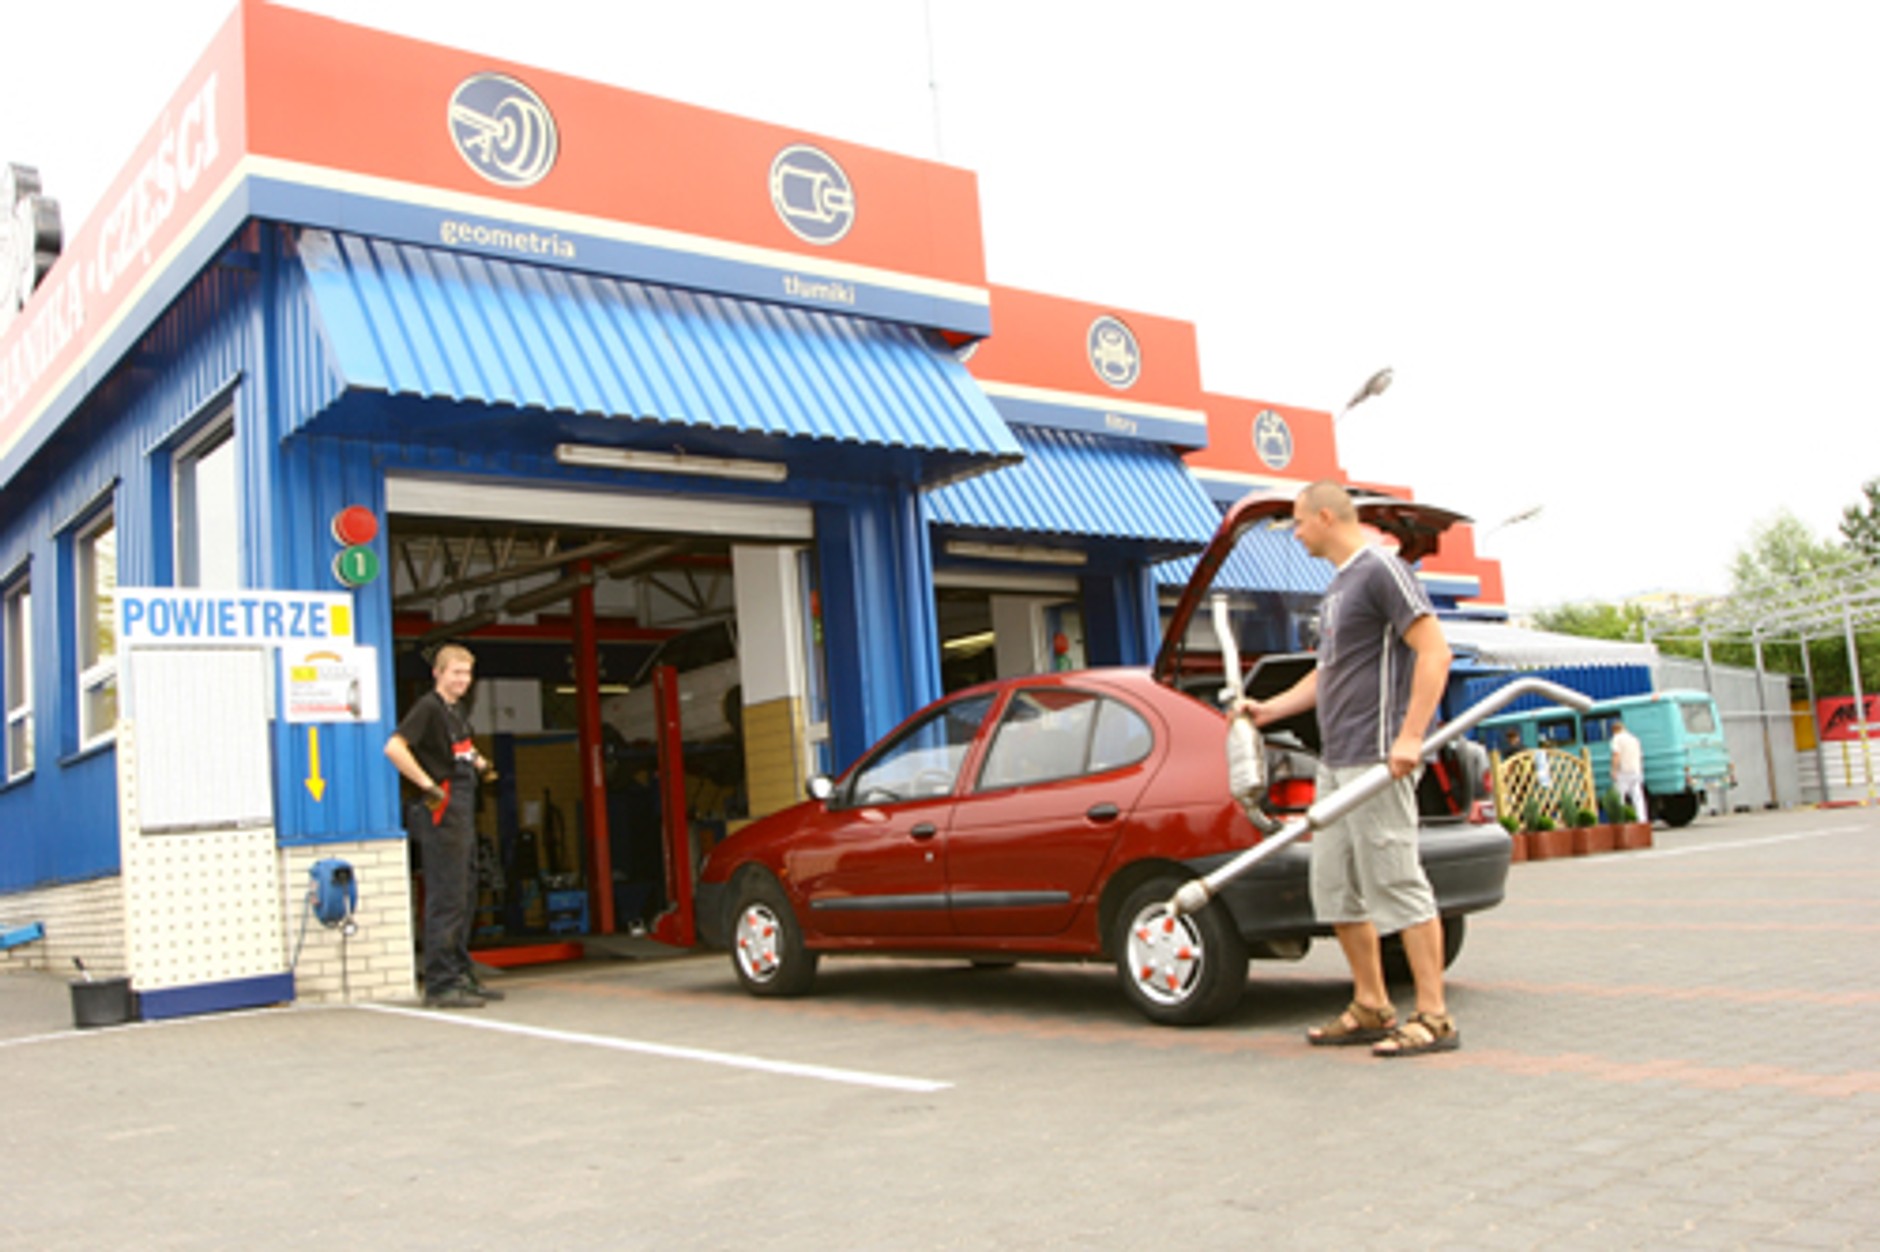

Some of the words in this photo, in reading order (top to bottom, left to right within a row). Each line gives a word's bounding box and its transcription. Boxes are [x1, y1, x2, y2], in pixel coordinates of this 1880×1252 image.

[441, 219, 576, 258] geometria
[354, 552, 366, 576] 1
[122, 598, 327, 637] POWIETRZE
